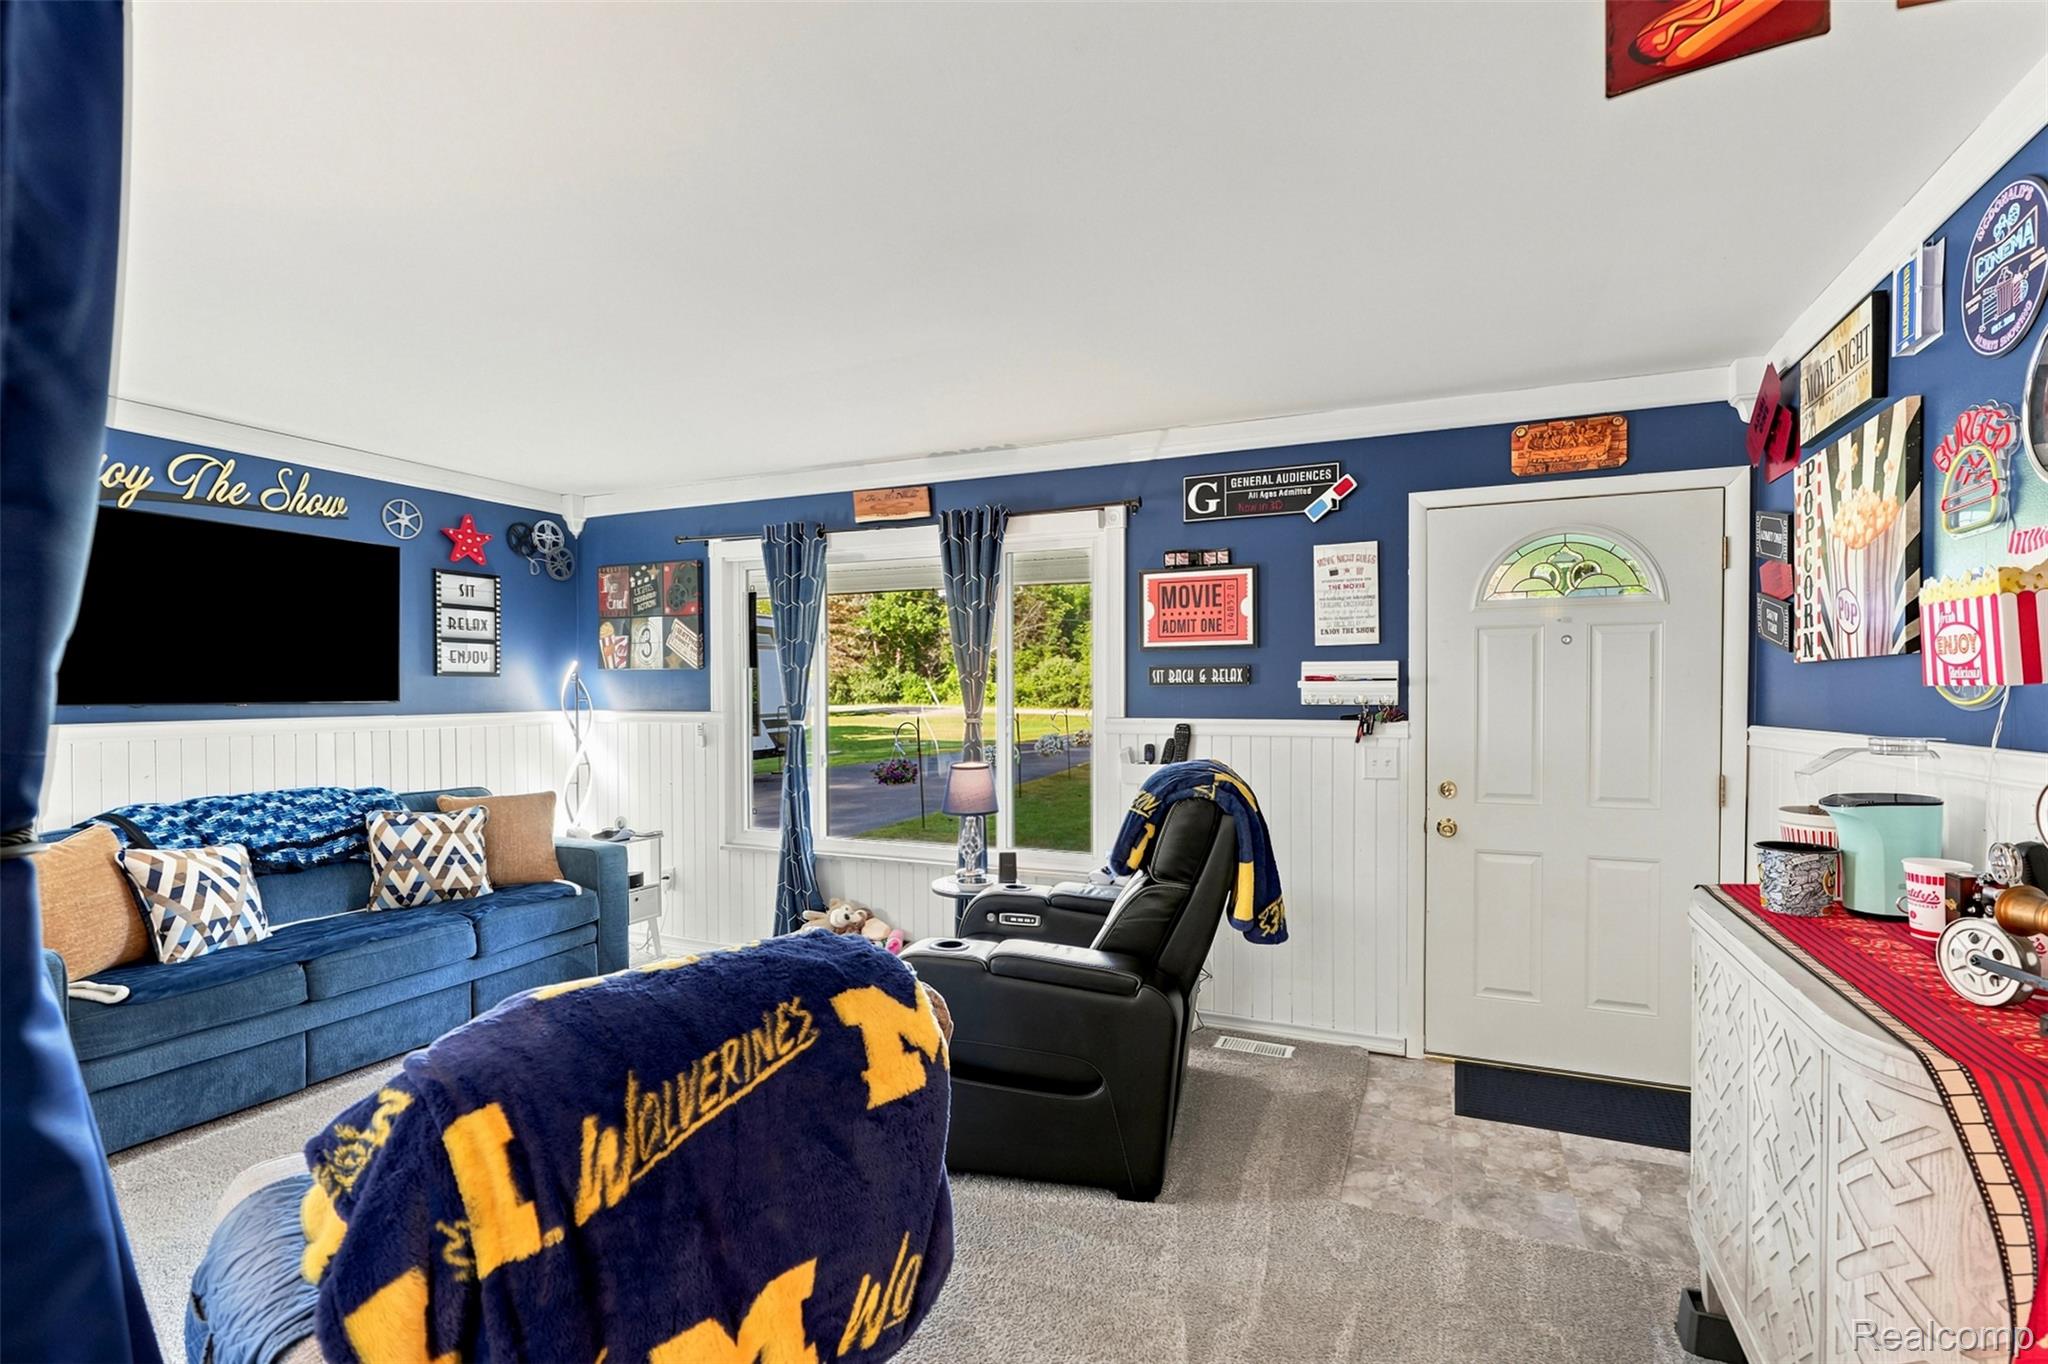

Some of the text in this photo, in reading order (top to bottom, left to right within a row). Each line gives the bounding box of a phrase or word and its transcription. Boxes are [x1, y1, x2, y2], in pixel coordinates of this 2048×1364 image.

[1975, 217, 2034, 284] CINEMA
[1804, 354, 1836, 406] MOVIE
[1837, 323, 1871, 380] NIGHT
[1932, 407, 2011, 473] BURGER
[167, 452, 251, 506] The
[260, 467, 348, 517] Show
[1230, 468, 1332, 489] GENERAL AUDIENCES
[1187, 481, 1221, 514] G
[1247, 486, 1312, 500] All Ages Admitted
[1269, 500, 1285, 510] 3D
[1803, 458, 1817, 658] POPCORN
[459, 583, 476, 598] SIT
[1161, 583, 1223, 610] MOVIE
[447, 616, 489, 632] RELAX
[1838, 595, 1859, 628] POP
[1161, 617, 1223, 634] ADMIT ONE
[1342, 627, 1355, 635] THE
[641, 627, 653, 658] 3
[1937, 633, 1977, 656] ENJOY
[447, 649, 489, 665] ENJOY
[1151, 667, 1243, 684] SIT BACK & RELAX
[574, 996, 821, 1228] WOLVERINES
